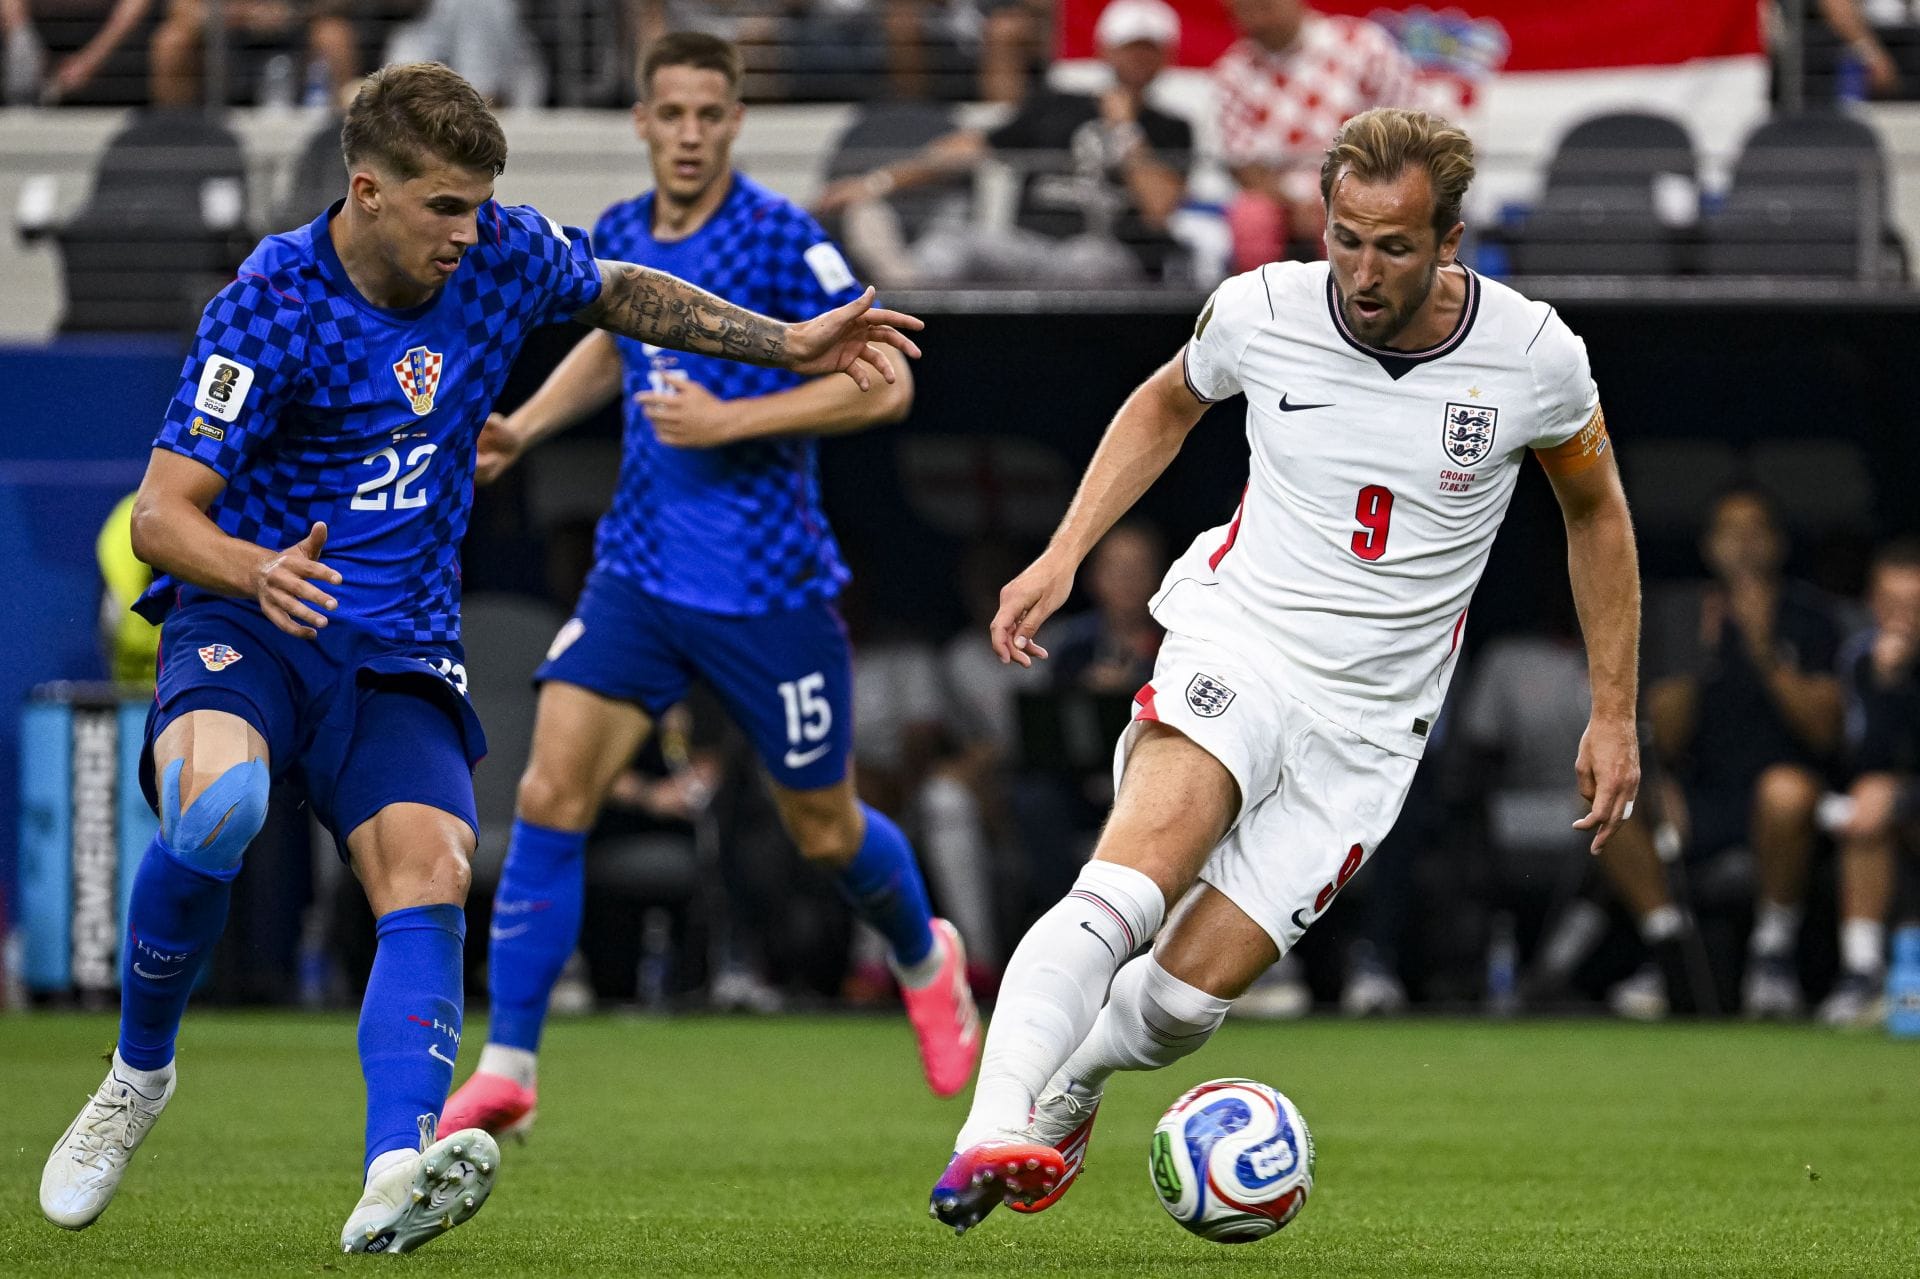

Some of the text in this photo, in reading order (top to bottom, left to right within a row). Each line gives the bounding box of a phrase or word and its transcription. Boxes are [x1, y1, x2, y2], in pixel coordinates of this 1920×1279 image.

[413, 355, 424, 389] HNS
[204, 402, 225, 414] 2026
[350, 443, 438, 511] 22
[1440, 470, 1476, 482] CROATIA
[1350, 484, 1395, 561] 9
[777, 671, 832, 744] 15
[1314, 842, 1364, 914] 9
[138, 940, 189, 963] HNS
[368, 1235, 390, 1252] KING
